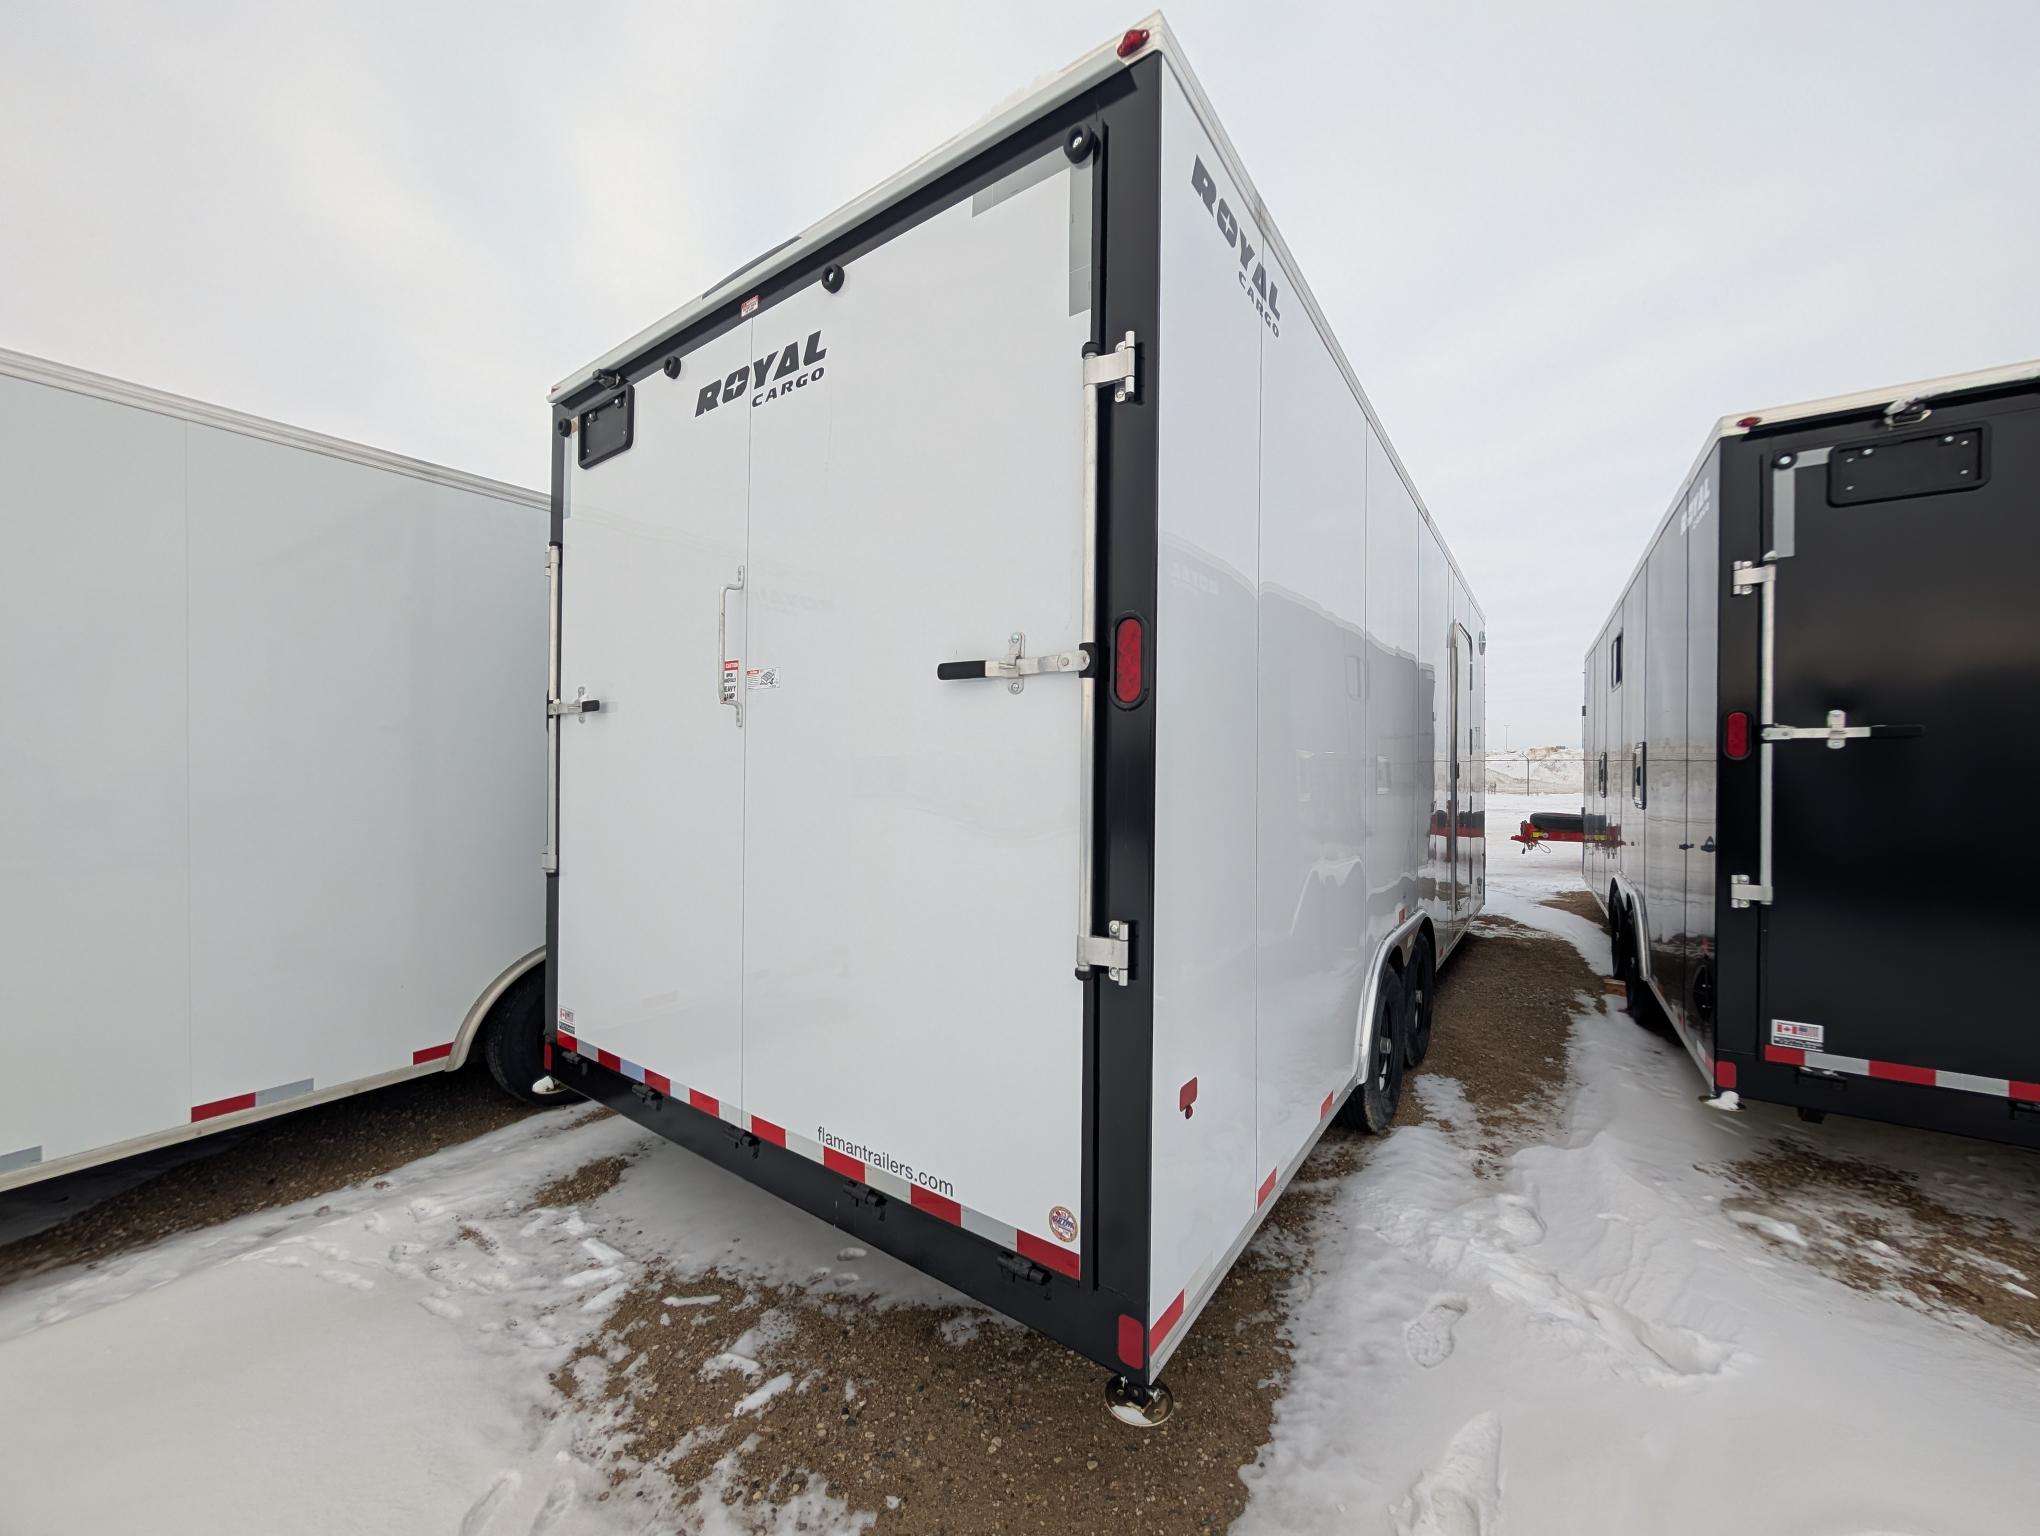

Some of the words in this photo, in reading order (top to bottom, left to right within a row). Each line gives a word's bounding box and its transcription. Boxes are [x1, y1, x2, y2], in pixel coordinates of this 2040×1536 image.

[1191, 154, 1280, 321] ROYAL
[1238, 271, 1280, 338] CARGO
[694, 329, 827, 418] ROYAL
[751, 366, 825, 408] CARGO
[817, 1126, 954, 1197] flamantrailers.com
